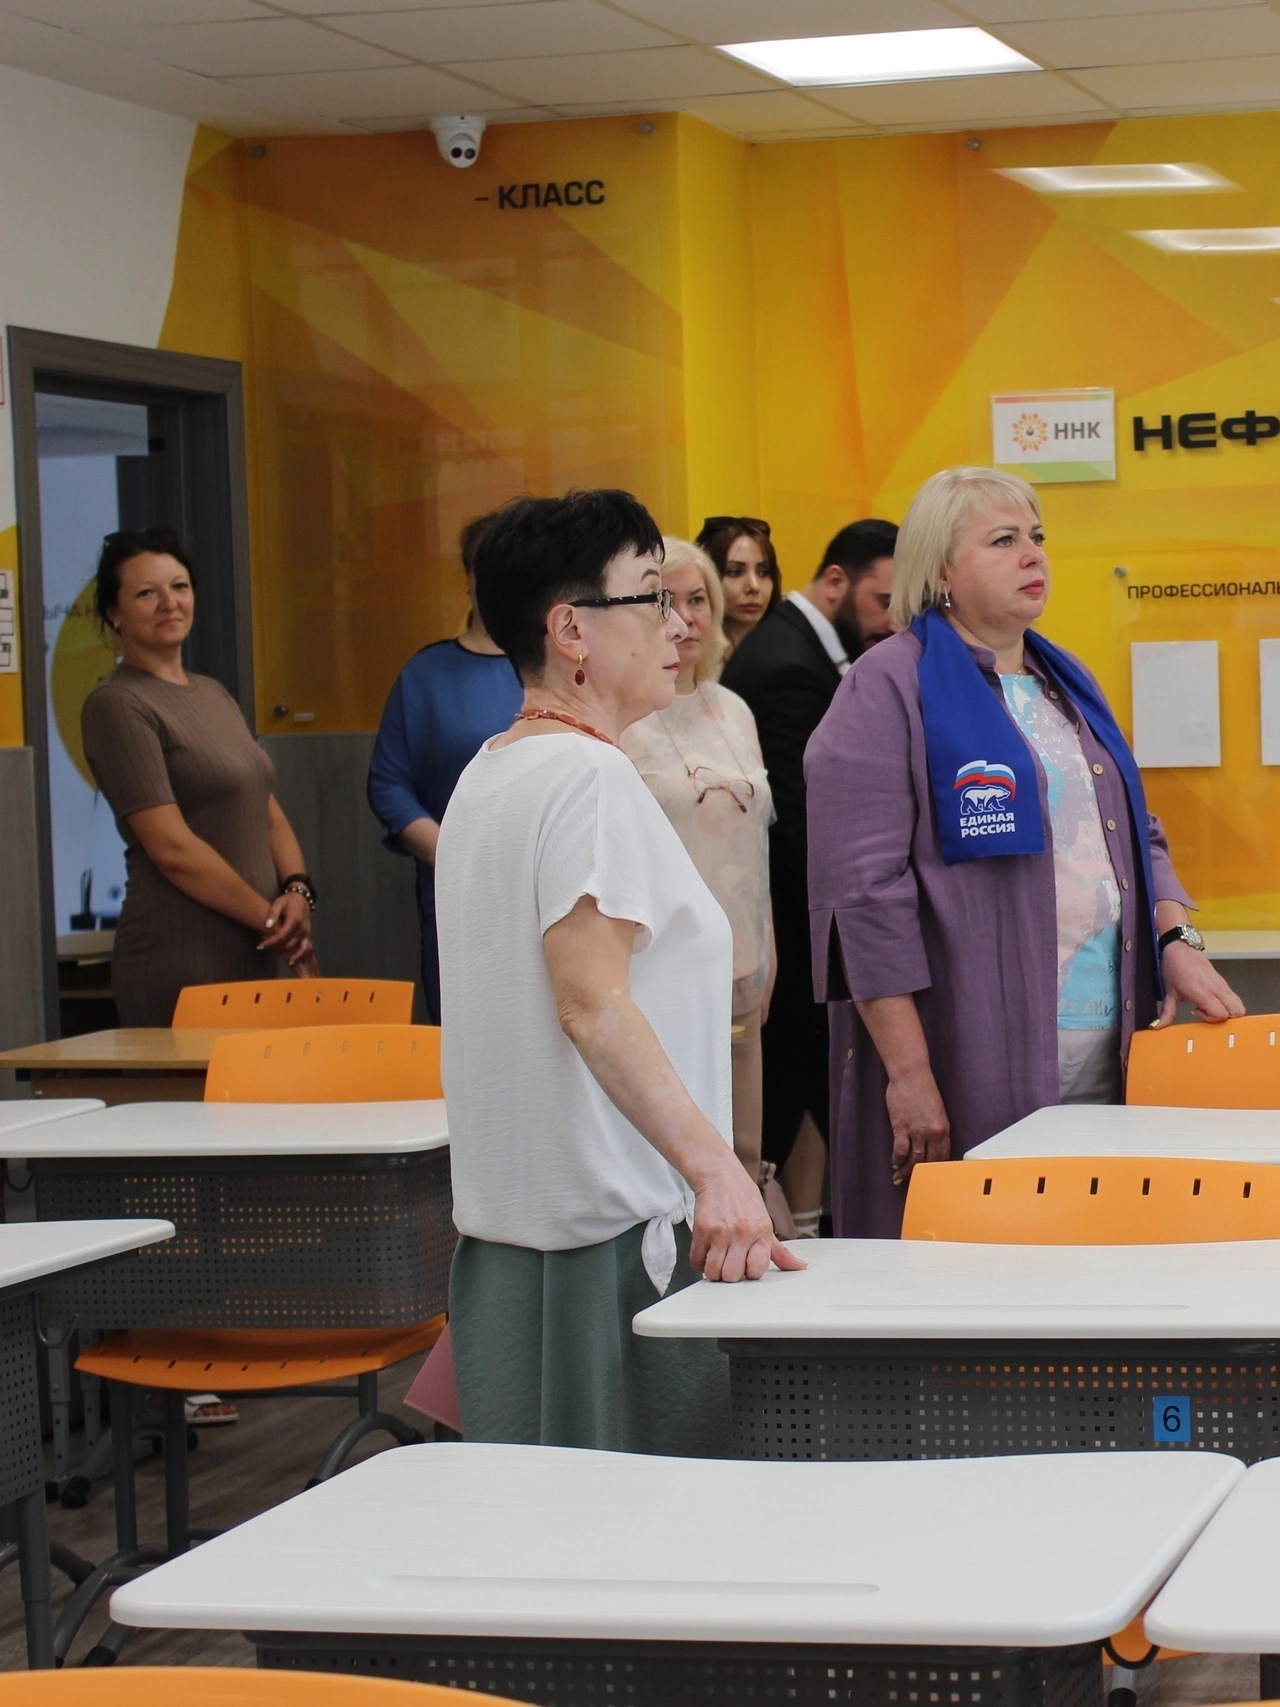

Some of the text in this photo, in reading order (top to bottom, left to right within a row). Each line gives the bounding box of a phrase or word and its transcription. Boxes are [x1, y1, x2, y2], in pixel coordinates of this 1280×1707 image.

[498, 180, 605, 210] КЛАСС
[1054, 421, 1101, 440] ННК
[959, 812, 1015, 828] ЕДИНАЯ
[960, 822, 1016, 838] РОССИЯ
[1162, 1405, 1182, 1433] 6
